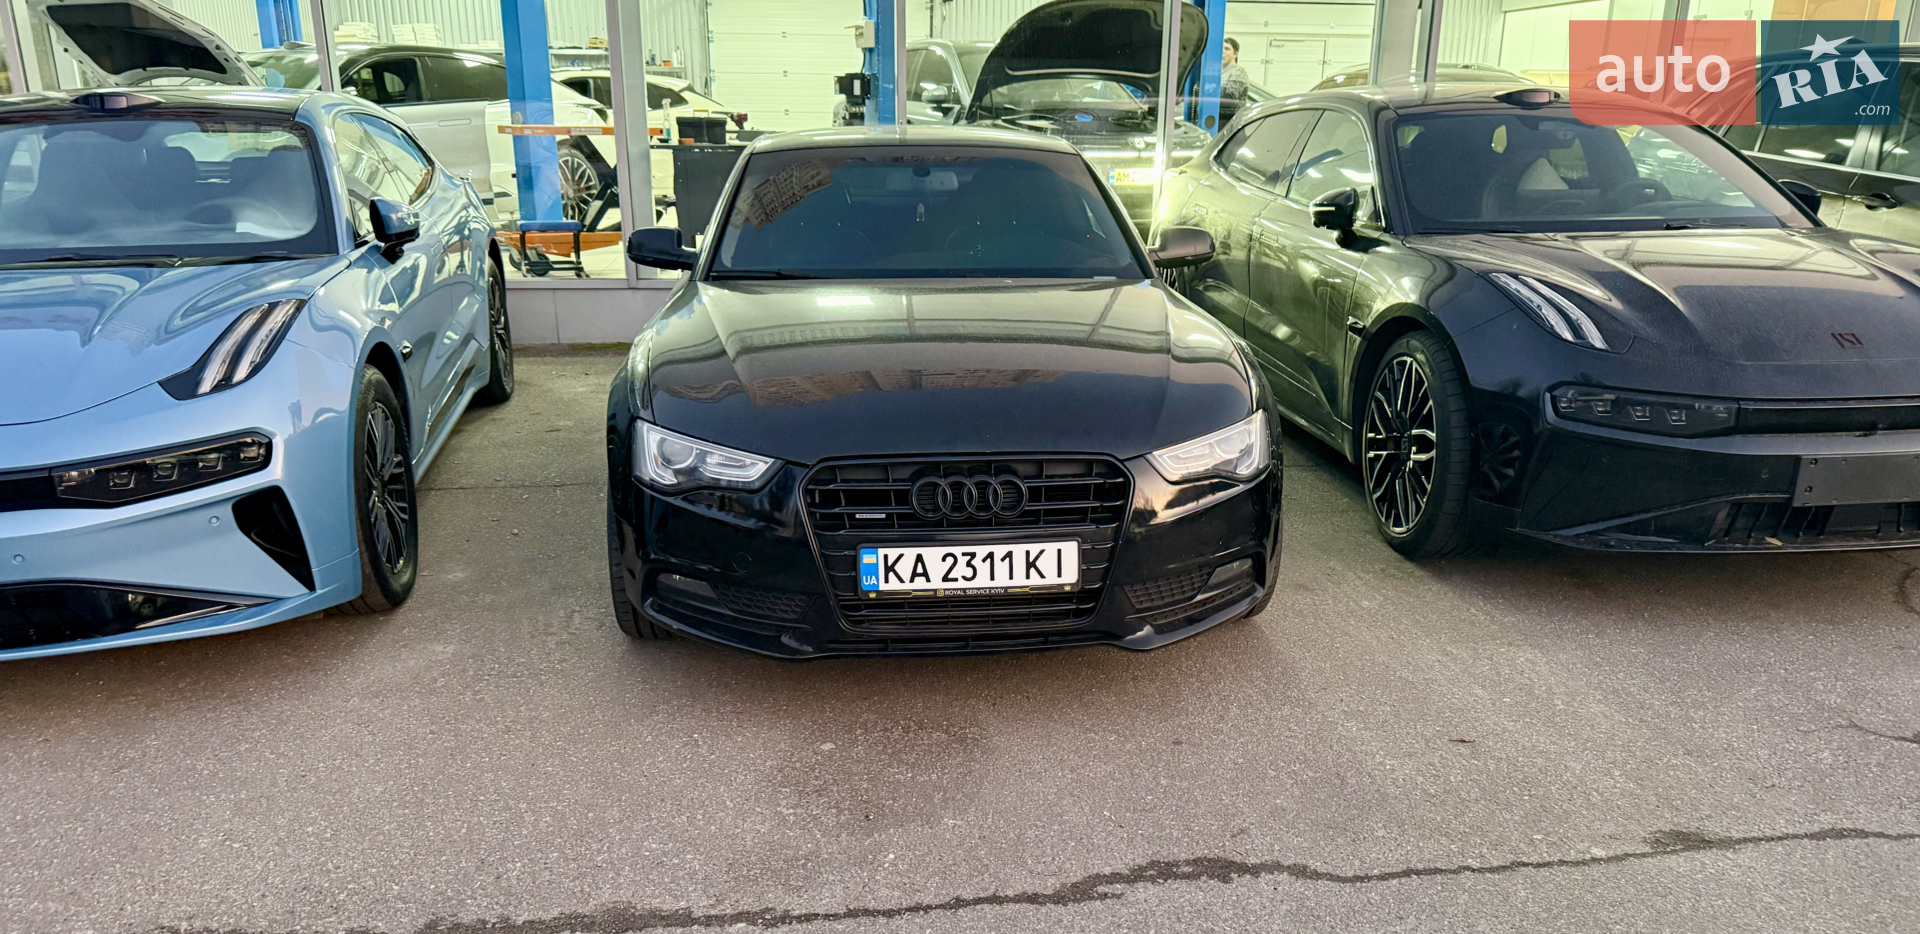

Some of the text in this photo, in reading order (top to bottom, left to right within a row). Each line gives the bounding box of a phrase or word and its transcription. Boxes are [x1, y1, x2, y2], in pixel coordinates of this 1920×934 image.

[883, 553, 931, 583] KA
[941, 550, 1014, 582] 2311
[863, 575, 878, 585] UA
